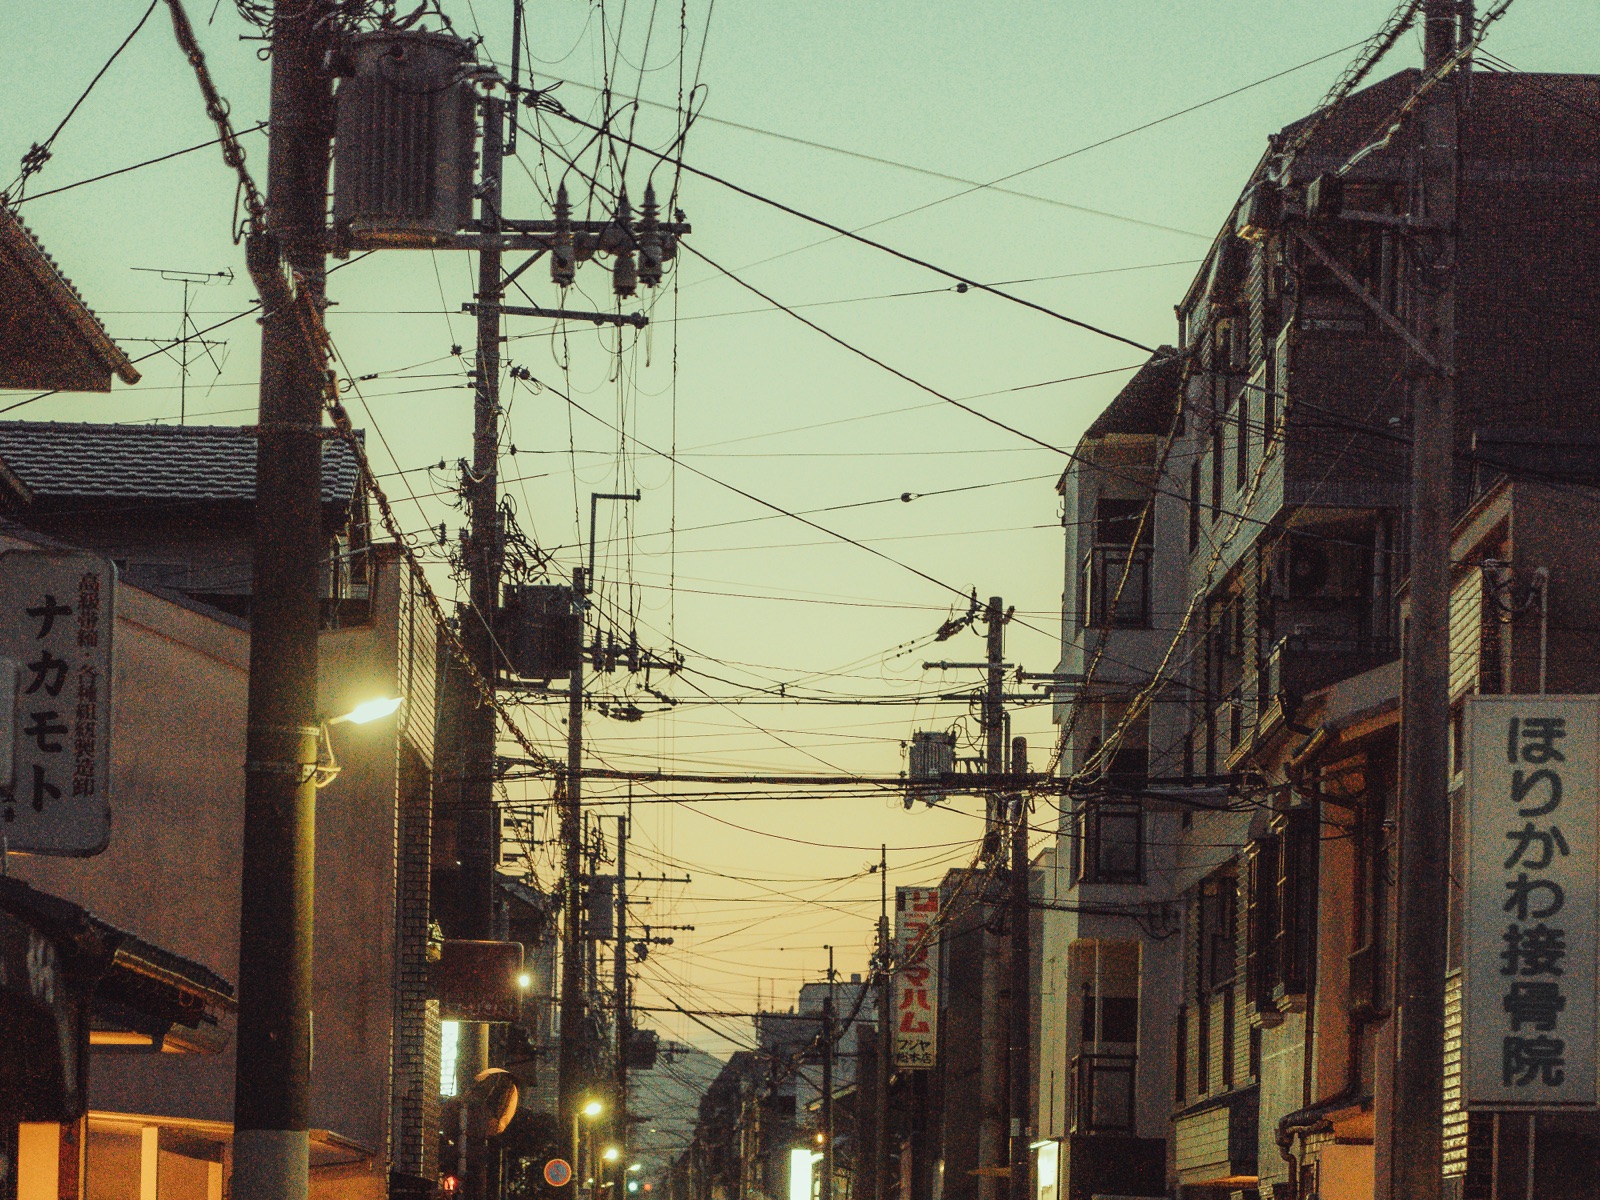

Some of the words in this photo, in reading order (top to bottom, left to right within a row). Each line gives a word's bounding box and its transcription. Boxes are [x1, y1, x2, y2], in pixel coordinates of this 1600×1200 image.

[24, 594, 73, 812] ナカモト
[1500, 716, 1570, 1088] ほりかわ接骨院
[897, 1039, 931, 1051] フジヤ
